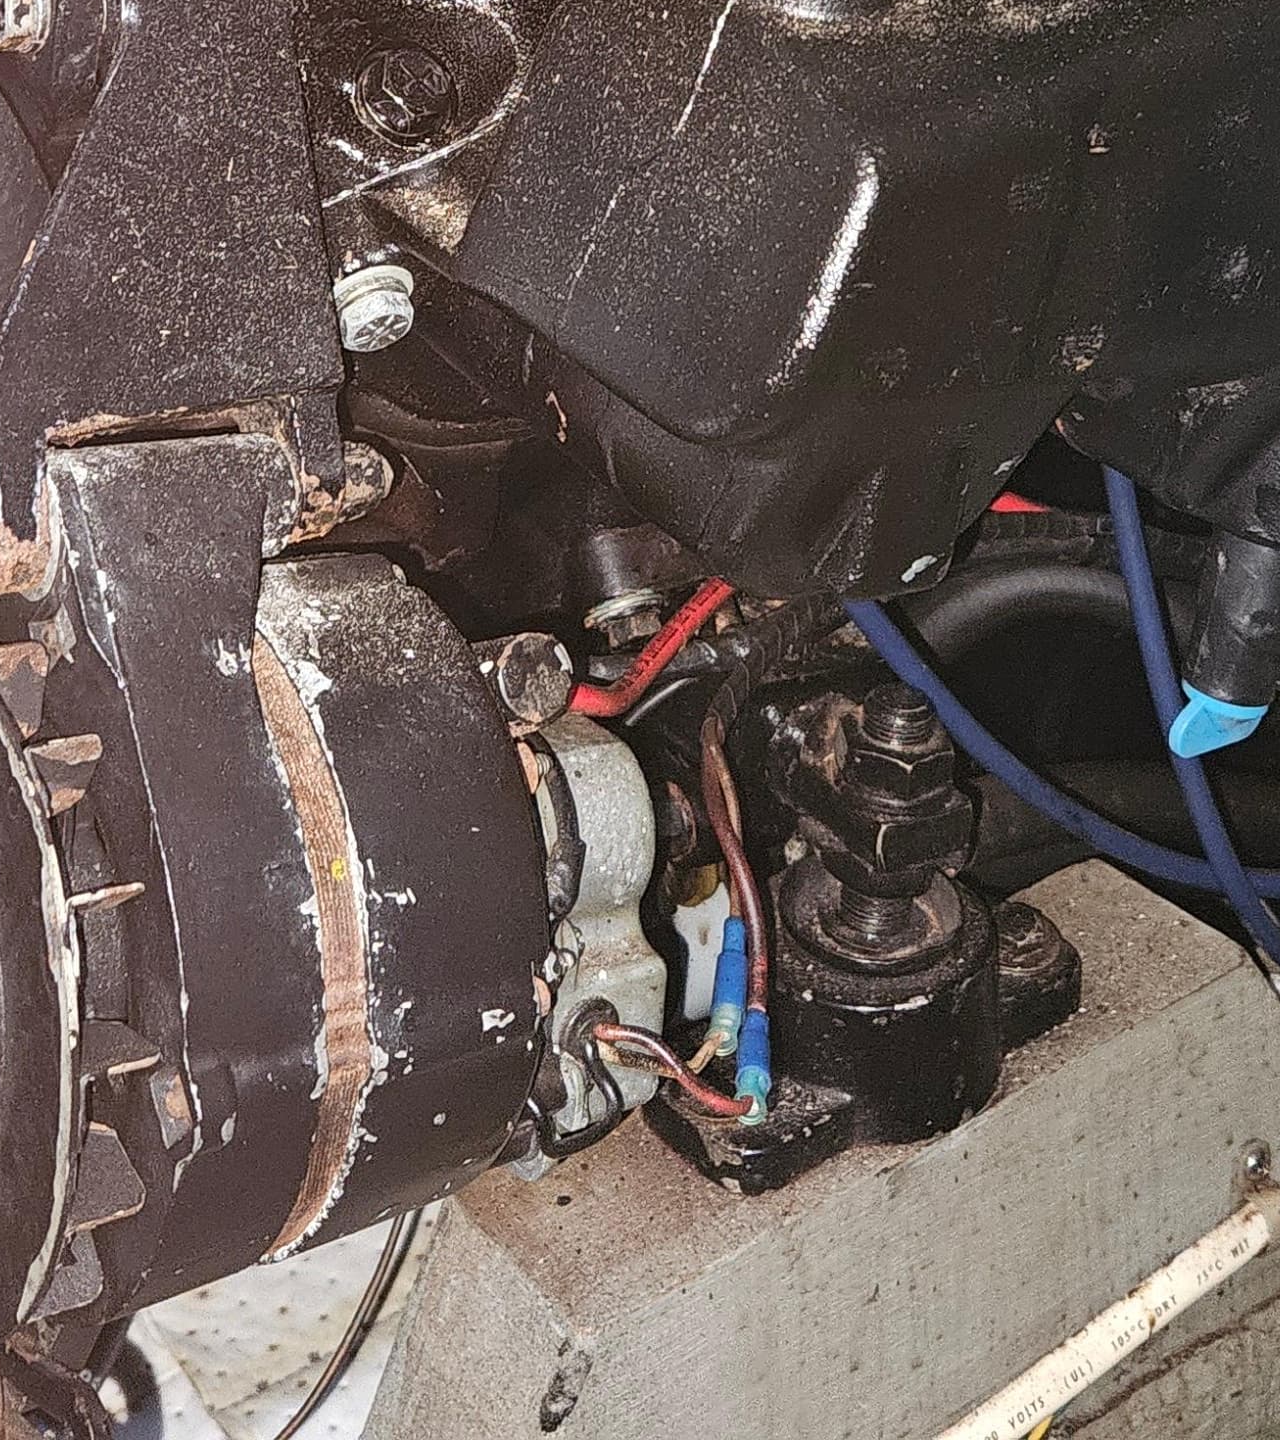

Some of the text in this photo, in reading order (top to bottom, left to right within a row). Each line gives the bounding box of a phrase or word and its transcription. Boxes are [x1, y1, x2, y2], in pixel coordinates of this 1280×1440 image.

[1008, 1397, 1046, 1430] VOLTS
[1064, 1360, 1094, 1390] (UL)
[1155, 1295, 1179, 1317] DRY
